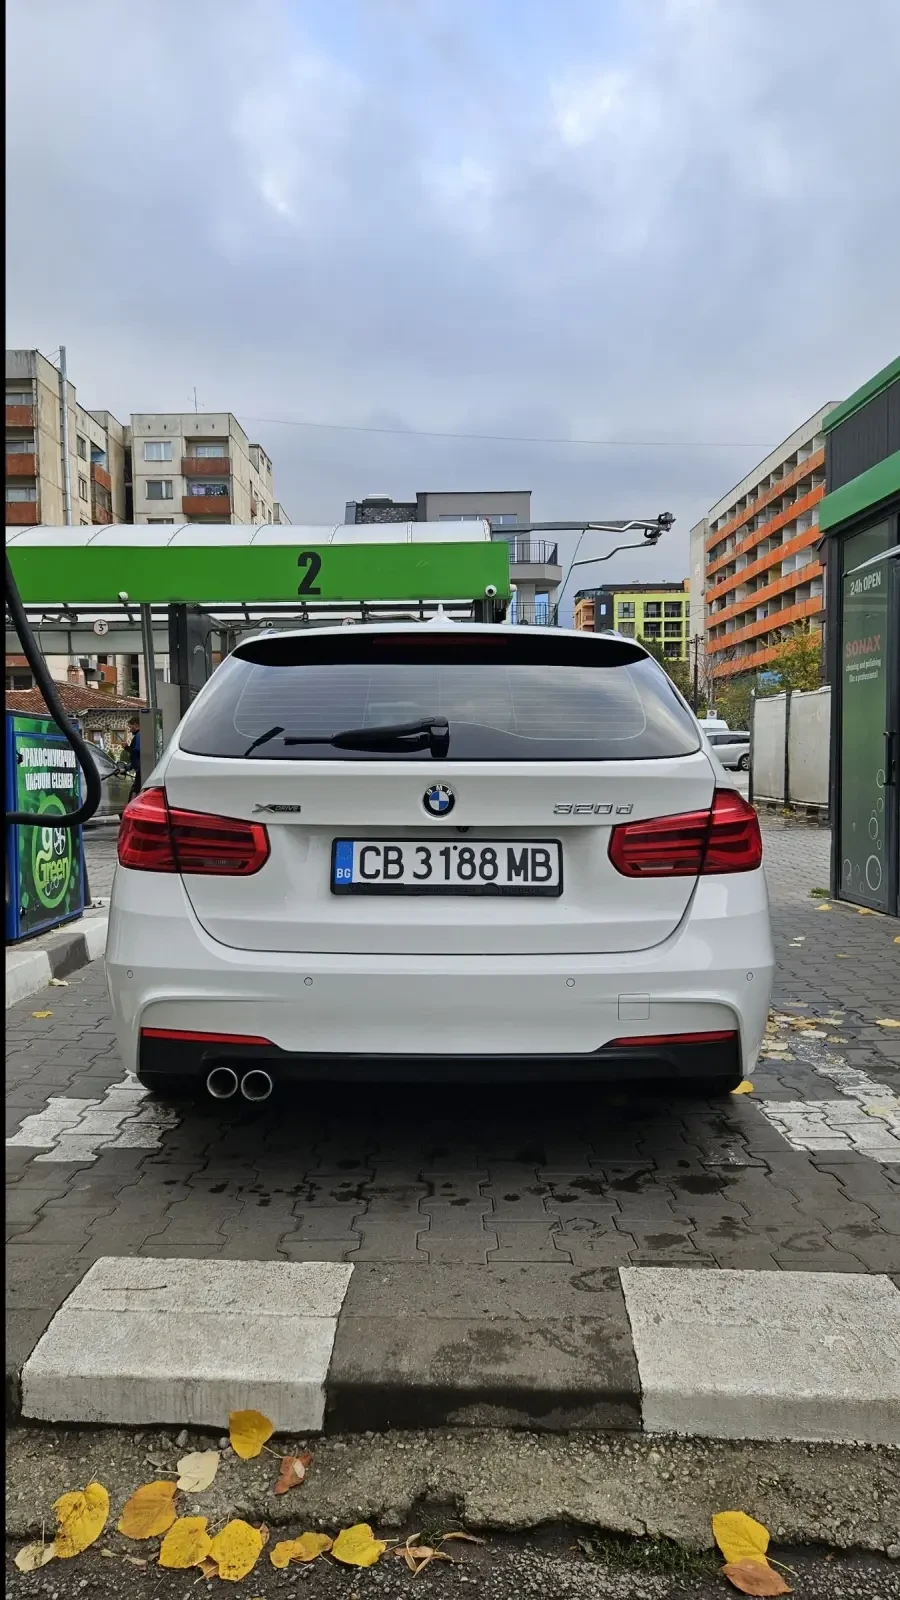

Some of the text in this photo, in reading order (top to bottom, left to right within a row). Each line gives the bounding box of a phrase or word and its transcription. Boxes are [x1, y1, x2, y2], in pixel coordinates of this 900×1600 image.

[297, 551, 322, 595] 2
[850, 572, 881, 595] 24h OPEN
[846, 634, 881, 658] SONAX
[25, 772, 73, 791] VACUUM CLEANER
[426, 784, 453, 796] BMW
[336, 868, 351, 879] BG
[359, 845, 553, 882] CB 3188 MB
